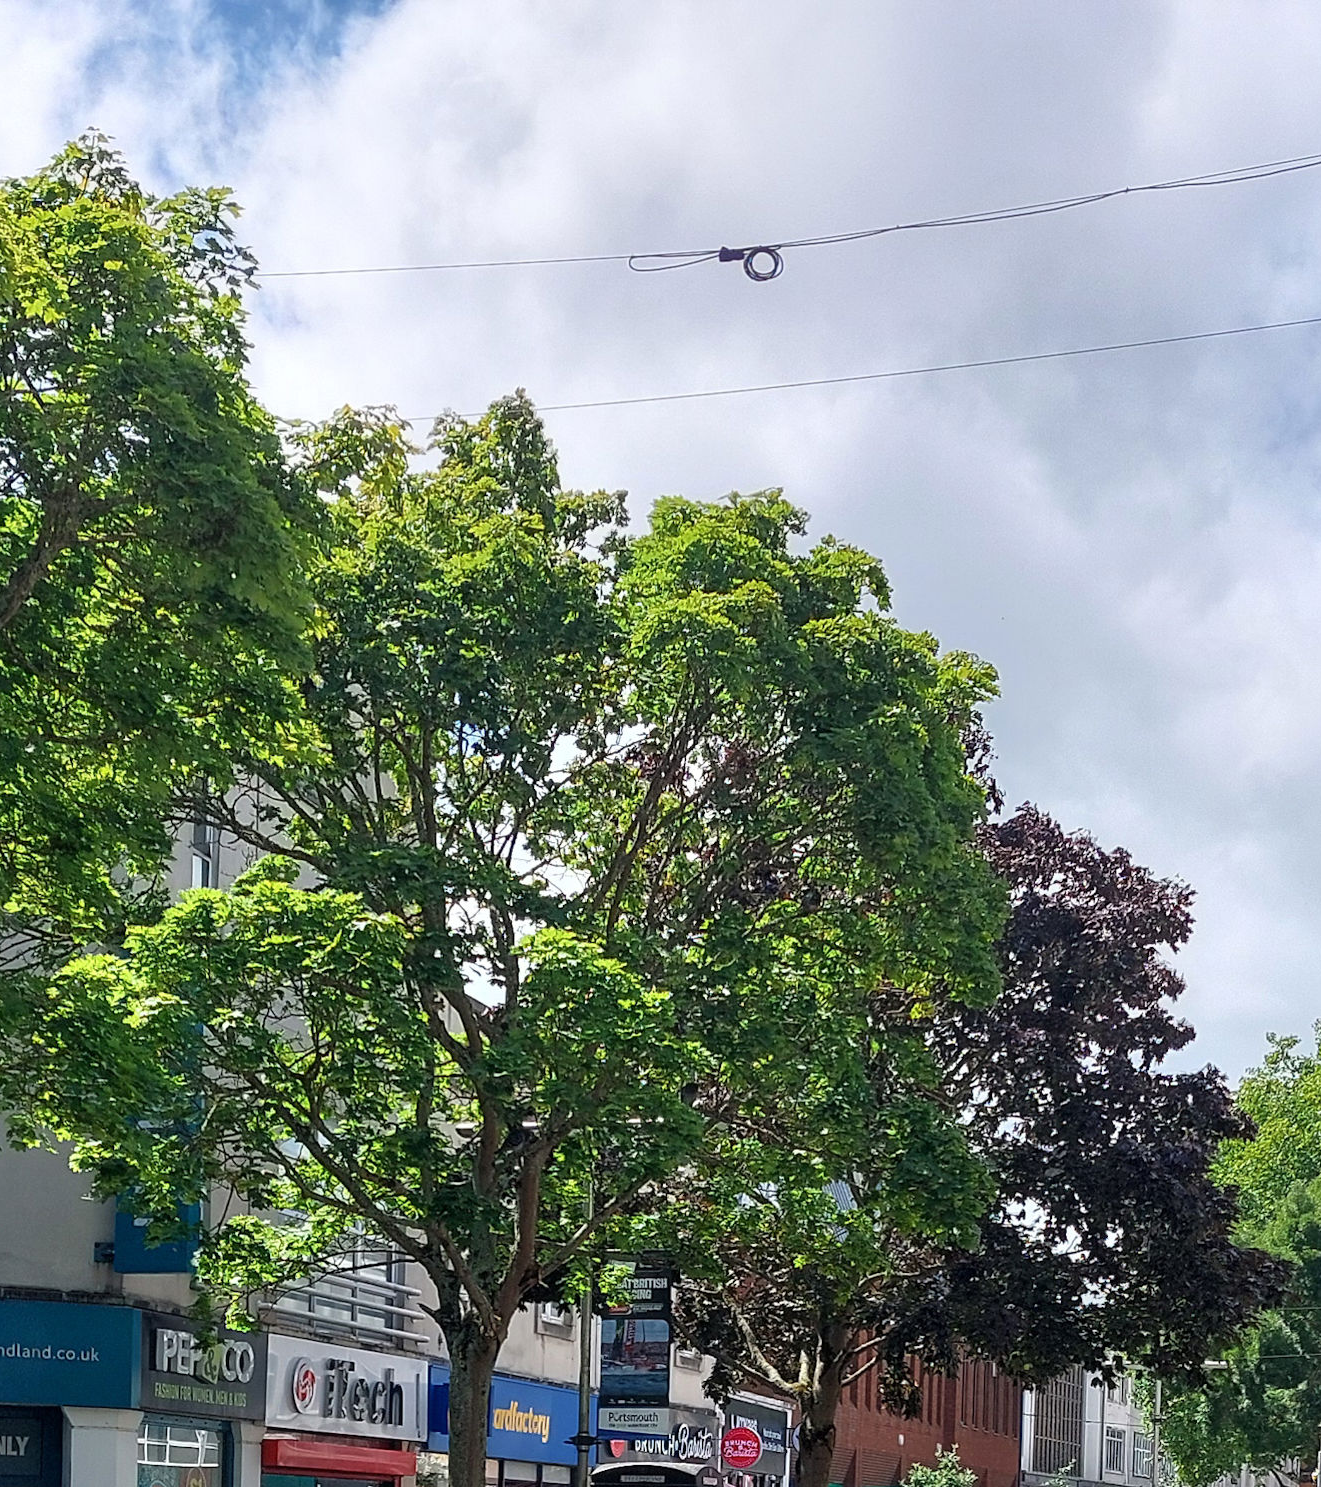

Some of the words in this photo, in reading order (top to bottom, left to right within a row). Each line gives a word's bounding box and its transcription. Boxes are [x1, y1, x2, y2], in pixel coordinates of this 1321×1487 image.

[323, 1357, 404, 1427] iTech
[492, 1400, 551, 1444] ardfactory
[608, 1411, 659, 1423] Portsmouth
[724, 1439, 758, 1448] BRUNCH
